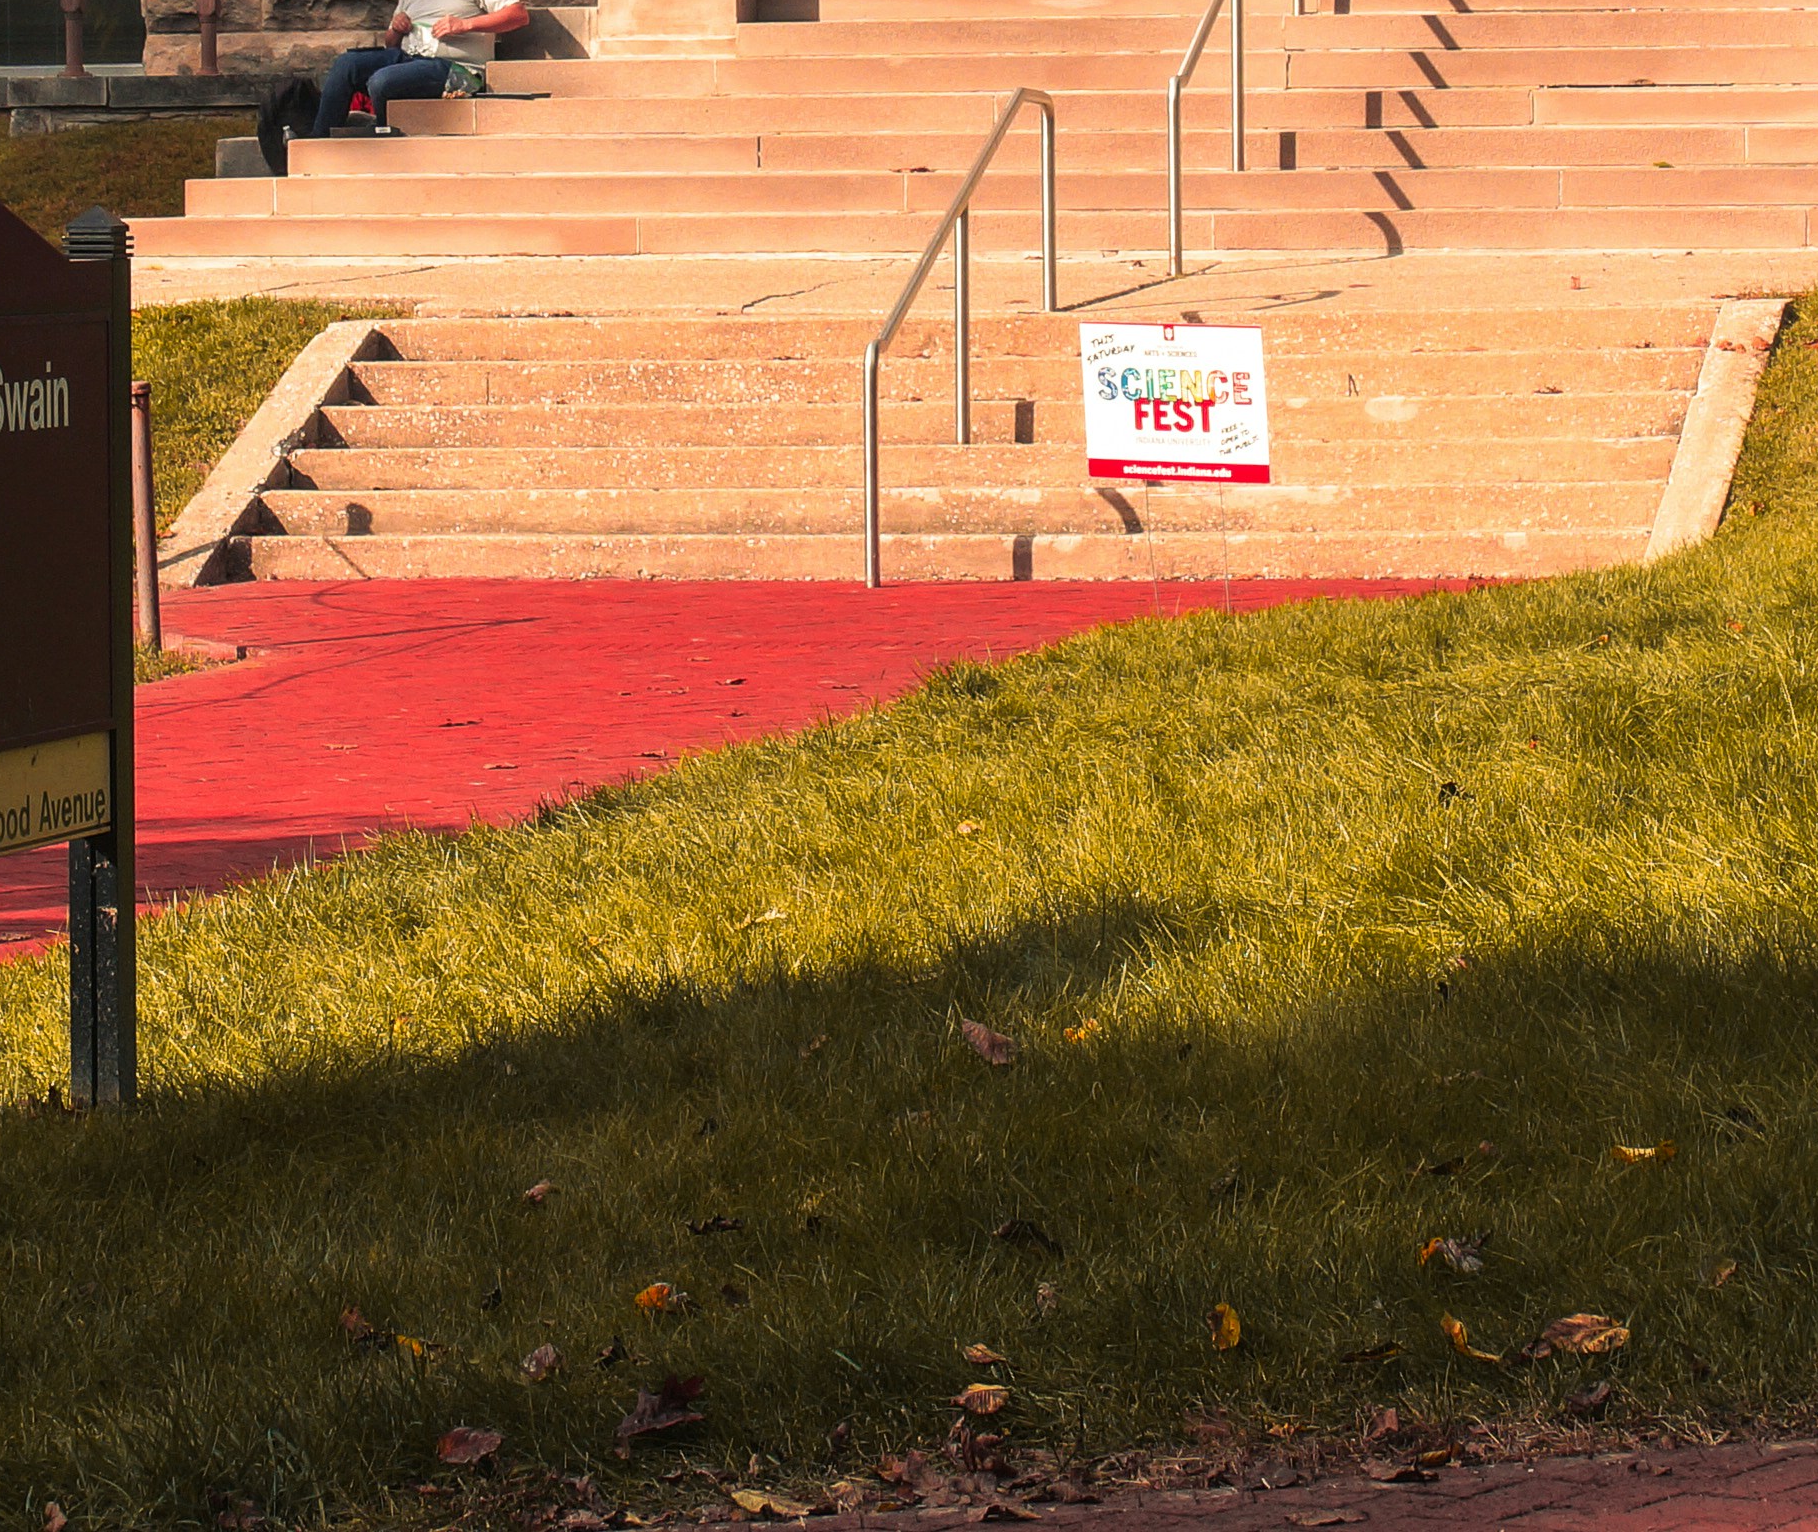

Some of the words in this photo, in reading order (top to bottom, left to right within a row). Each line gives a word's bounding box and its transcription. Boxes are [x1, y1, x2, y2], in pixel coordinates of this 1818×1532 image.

[1086, 344, 1135, 364] SATURDAY
[1090, 333, 1114, 347] THIS
[1097, 366, 1253, 406] SCIENCE
[1133, 397, 1216, 433] FEST
[1122, 464, 1232, 478] sciencefest.indiana.edu
[39, 788, 105, 831] Avenue
